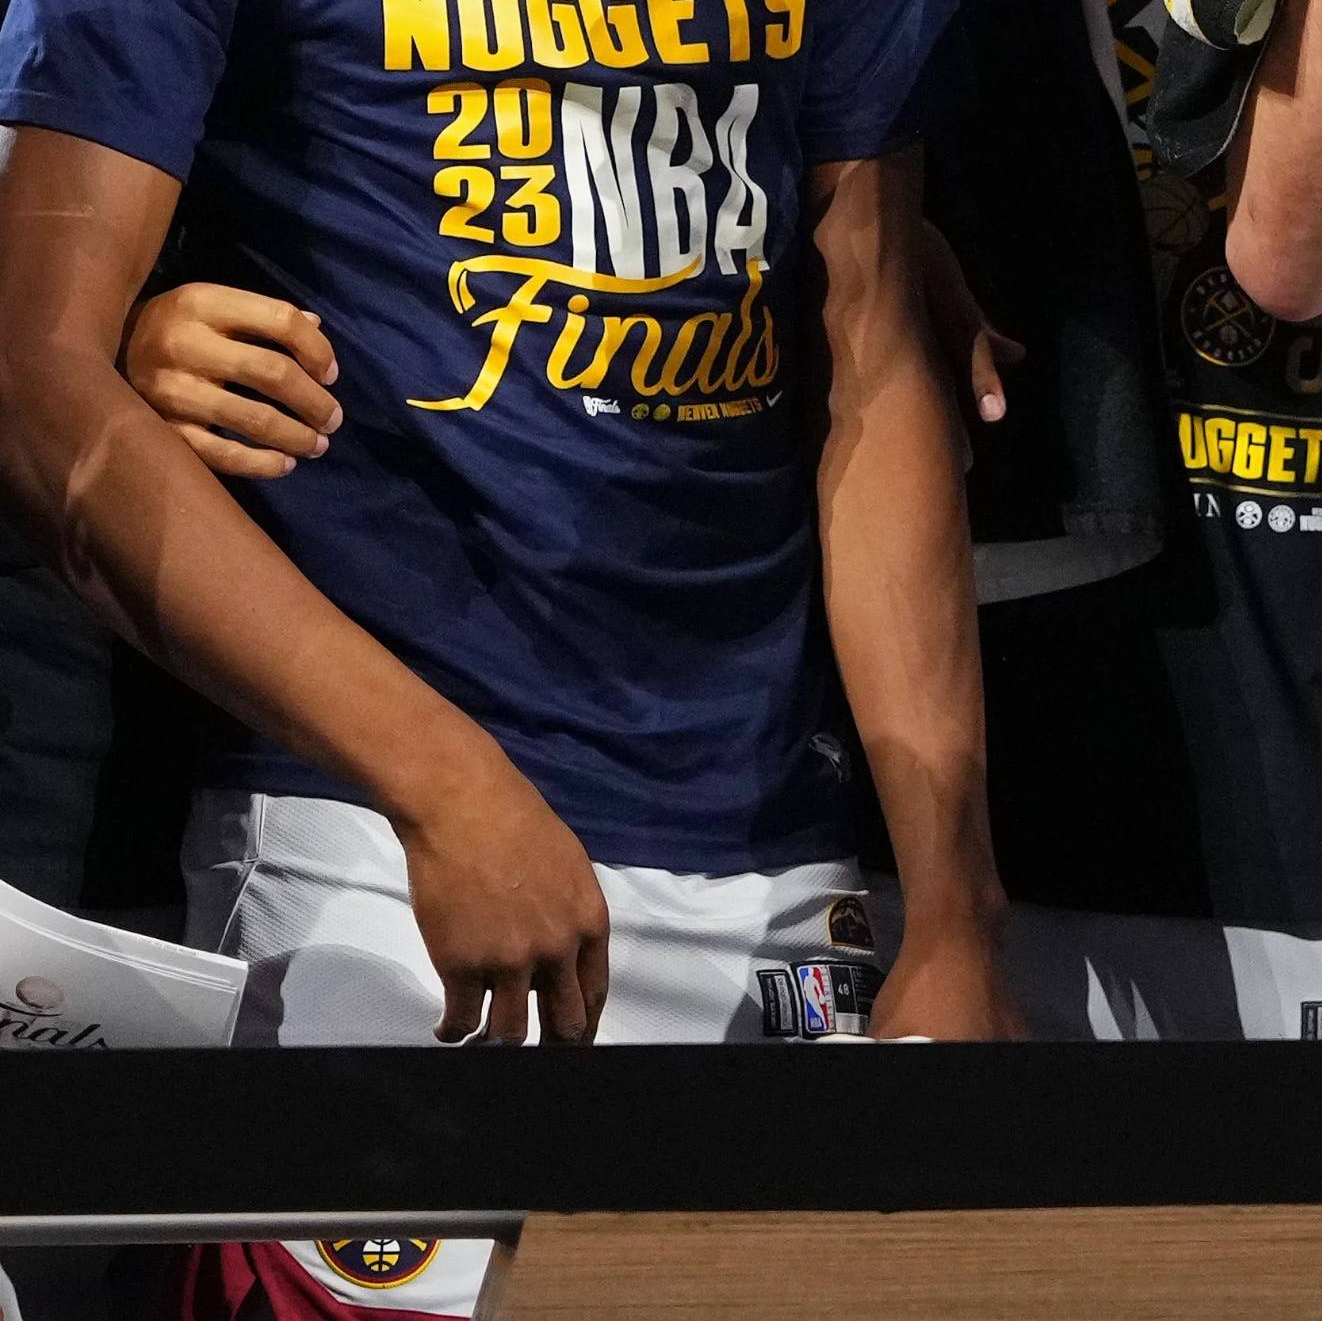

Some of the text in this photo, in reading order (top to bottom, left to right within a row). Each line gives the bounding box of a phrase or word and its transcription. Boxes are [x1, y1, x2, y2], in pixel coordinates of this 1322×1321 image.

[426, 76, 771, 281] 20 NBA
[432, 164, 562, 247] 23
[405, 253, 780, 413] Finals
